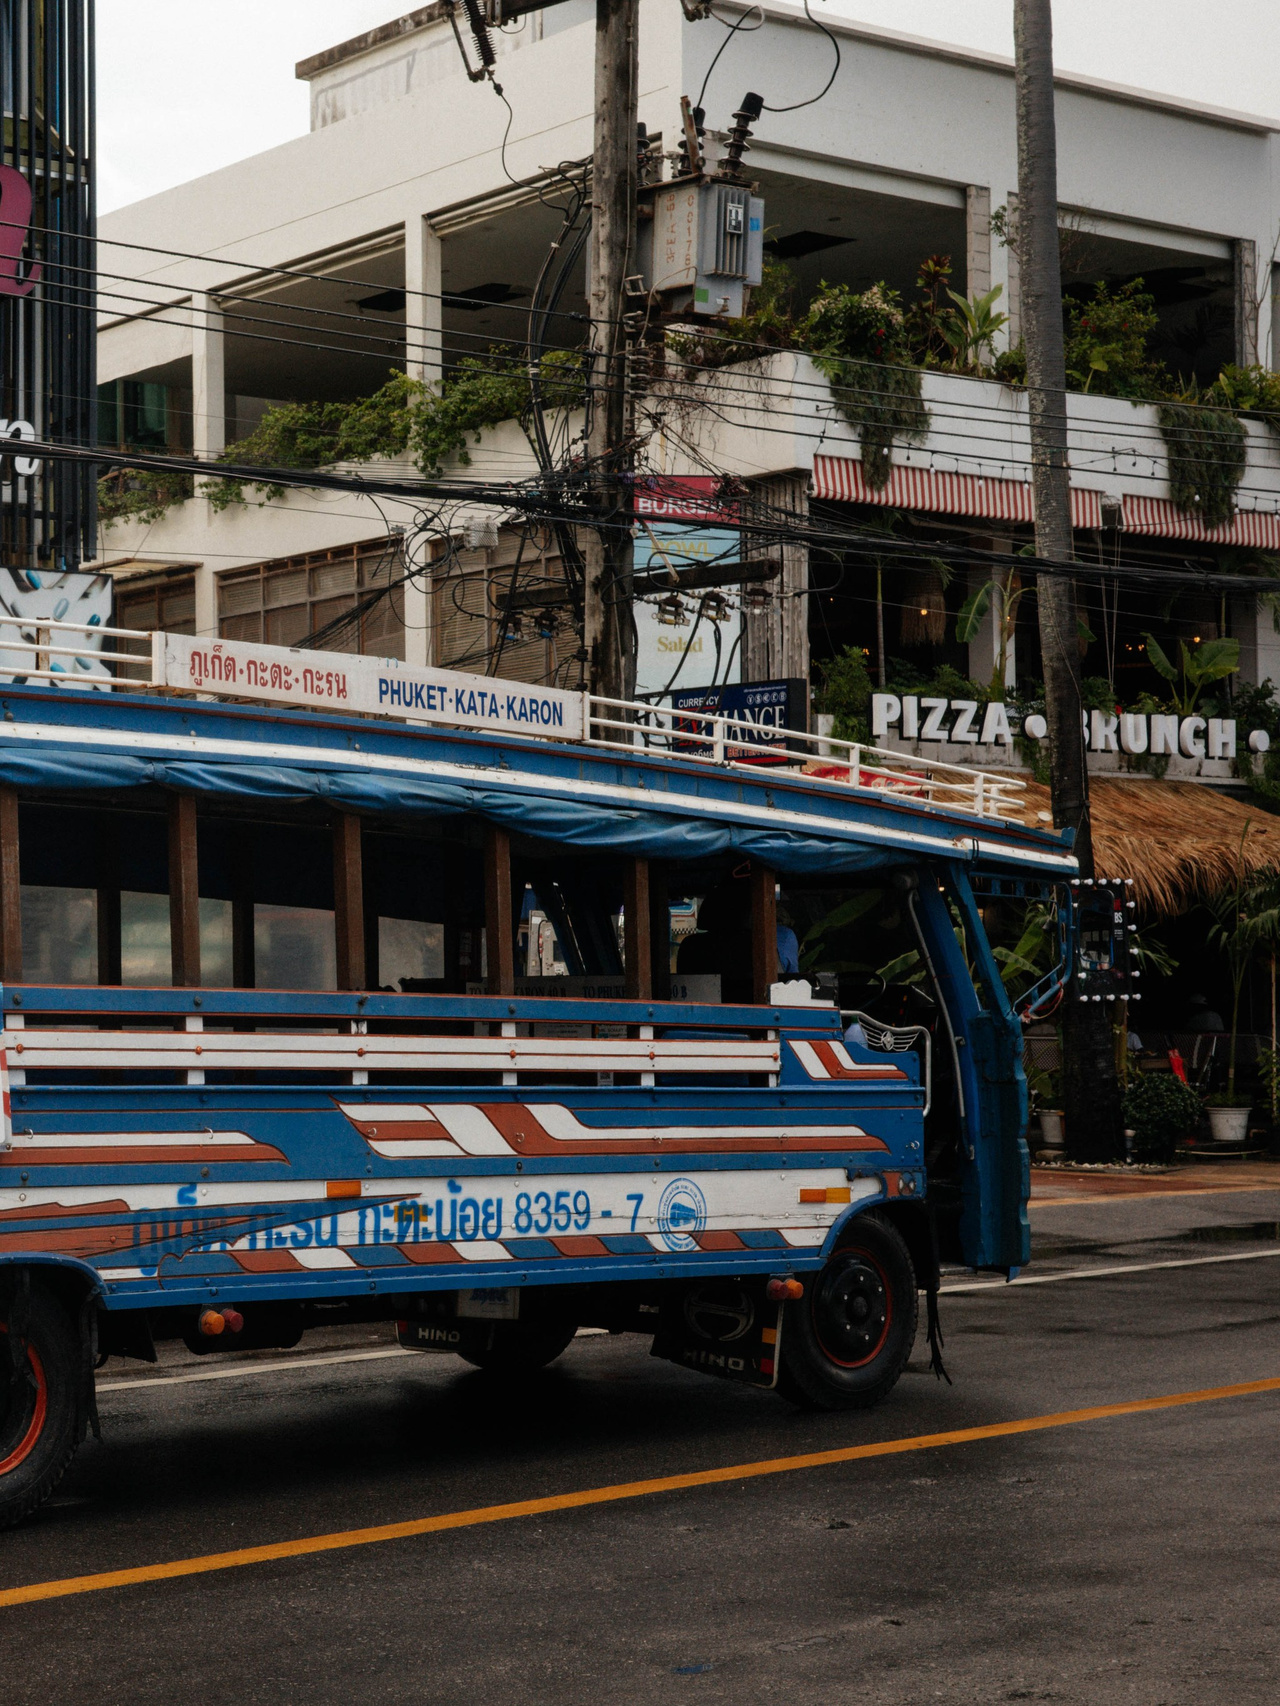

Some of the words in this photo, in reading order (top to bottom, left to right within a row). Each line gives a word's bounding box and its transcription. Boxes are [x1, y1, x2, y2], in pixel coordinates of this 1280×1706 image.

[657, 636, 704, 653] Salad
[678, 695, 720, 708] CURRENCY
[872, 693, 1013, 744] PIZZA
[1083, 709, 1237, 758] RUNCH
[598, 986, 626, 998] PHUKE
[514, 1190, 592, 1234] 8359
[418, 1327, 460, 1343] HINO
